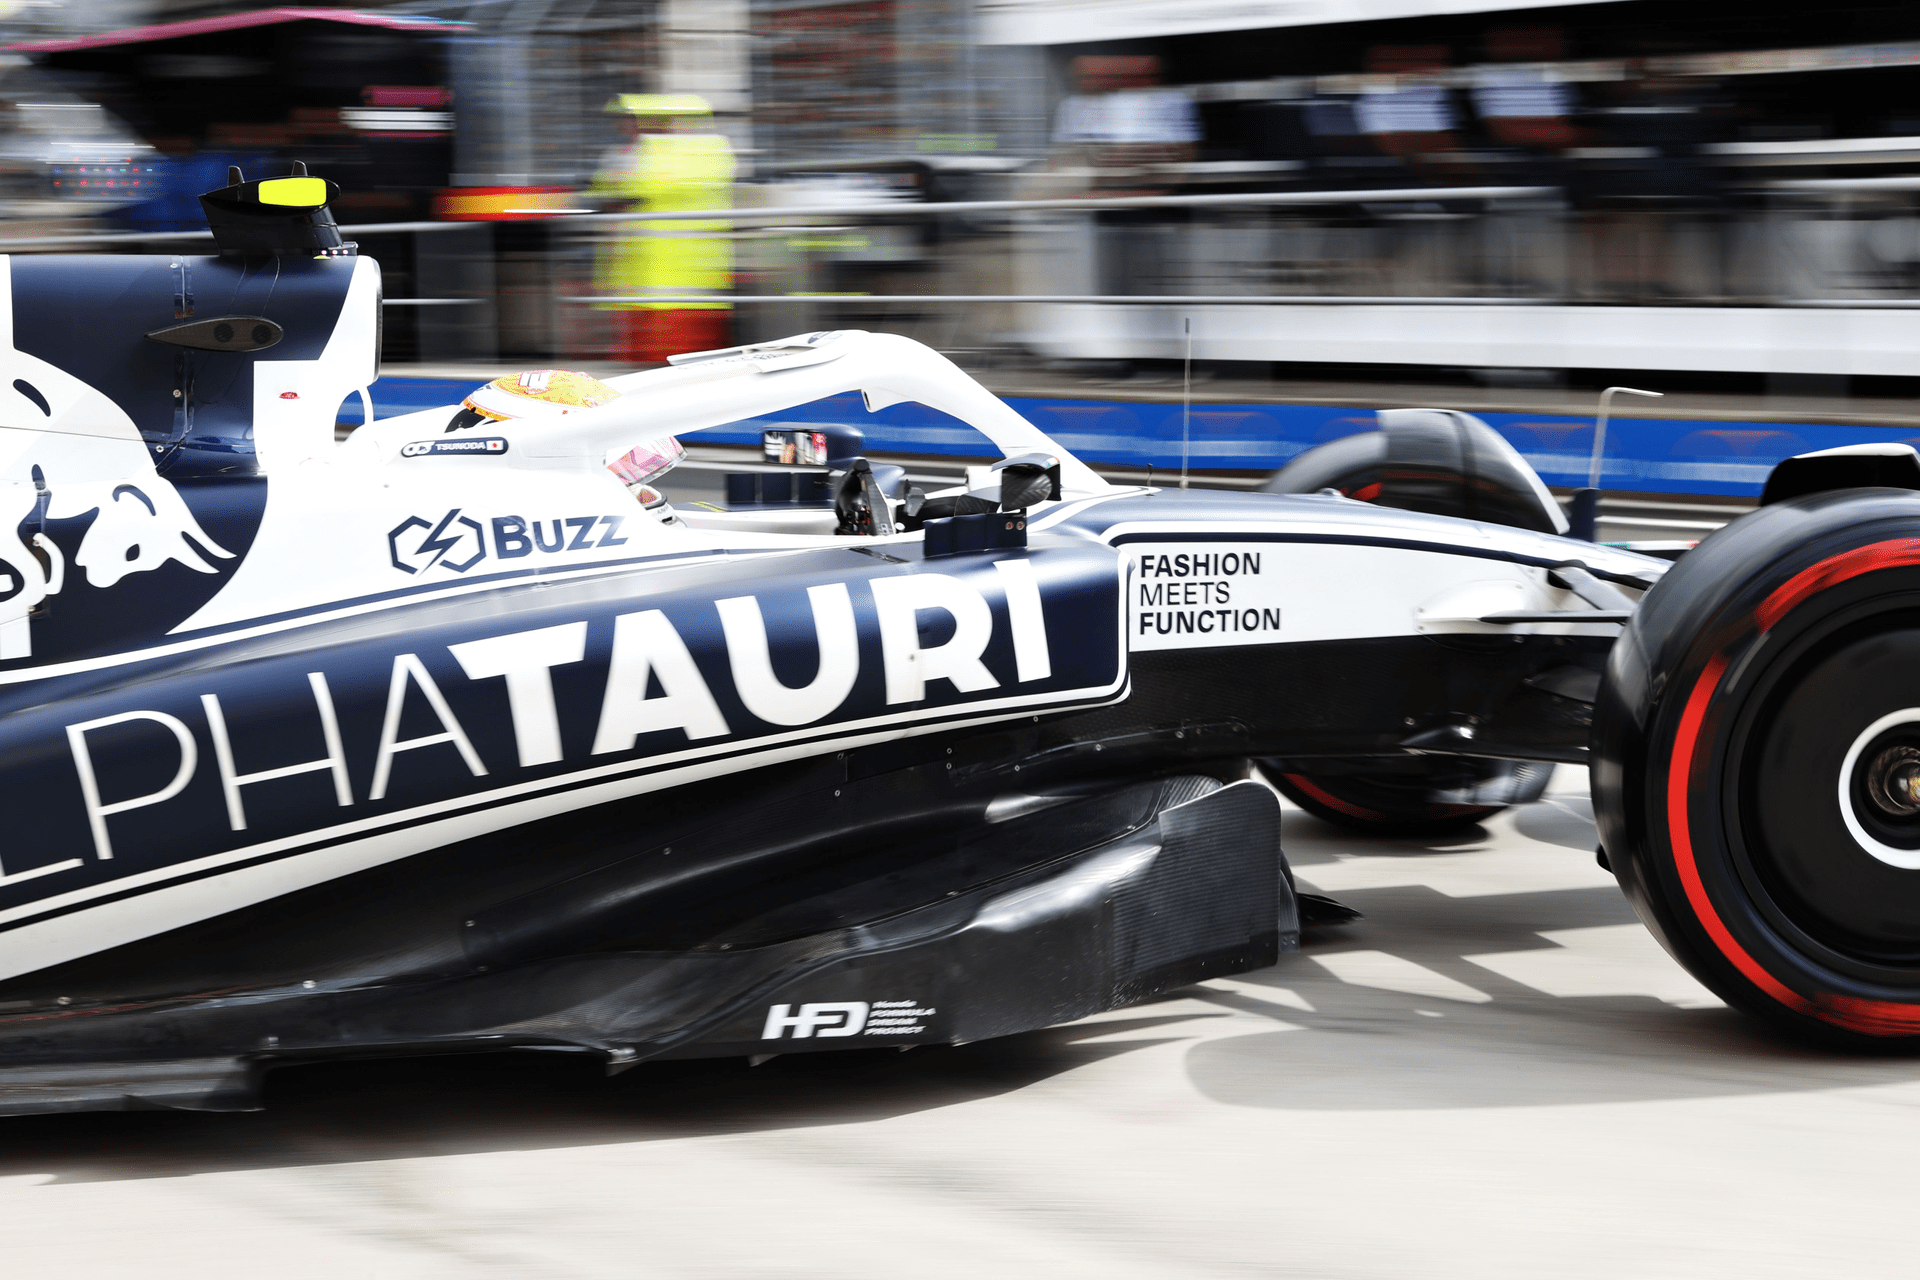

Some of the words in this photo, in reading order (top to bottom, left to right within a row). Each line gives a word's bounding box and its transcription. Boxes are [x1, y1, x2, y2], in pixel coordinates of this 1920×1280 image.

[434, 441, 487, 451] TSUNODA
[492, 515, 629, 560] BUZZ
[1140, 552, 1261, 578] FASHION
[1140, 581, 1230, 606] MEETS
[1139, 608, 1281, 635] FUNCTION
